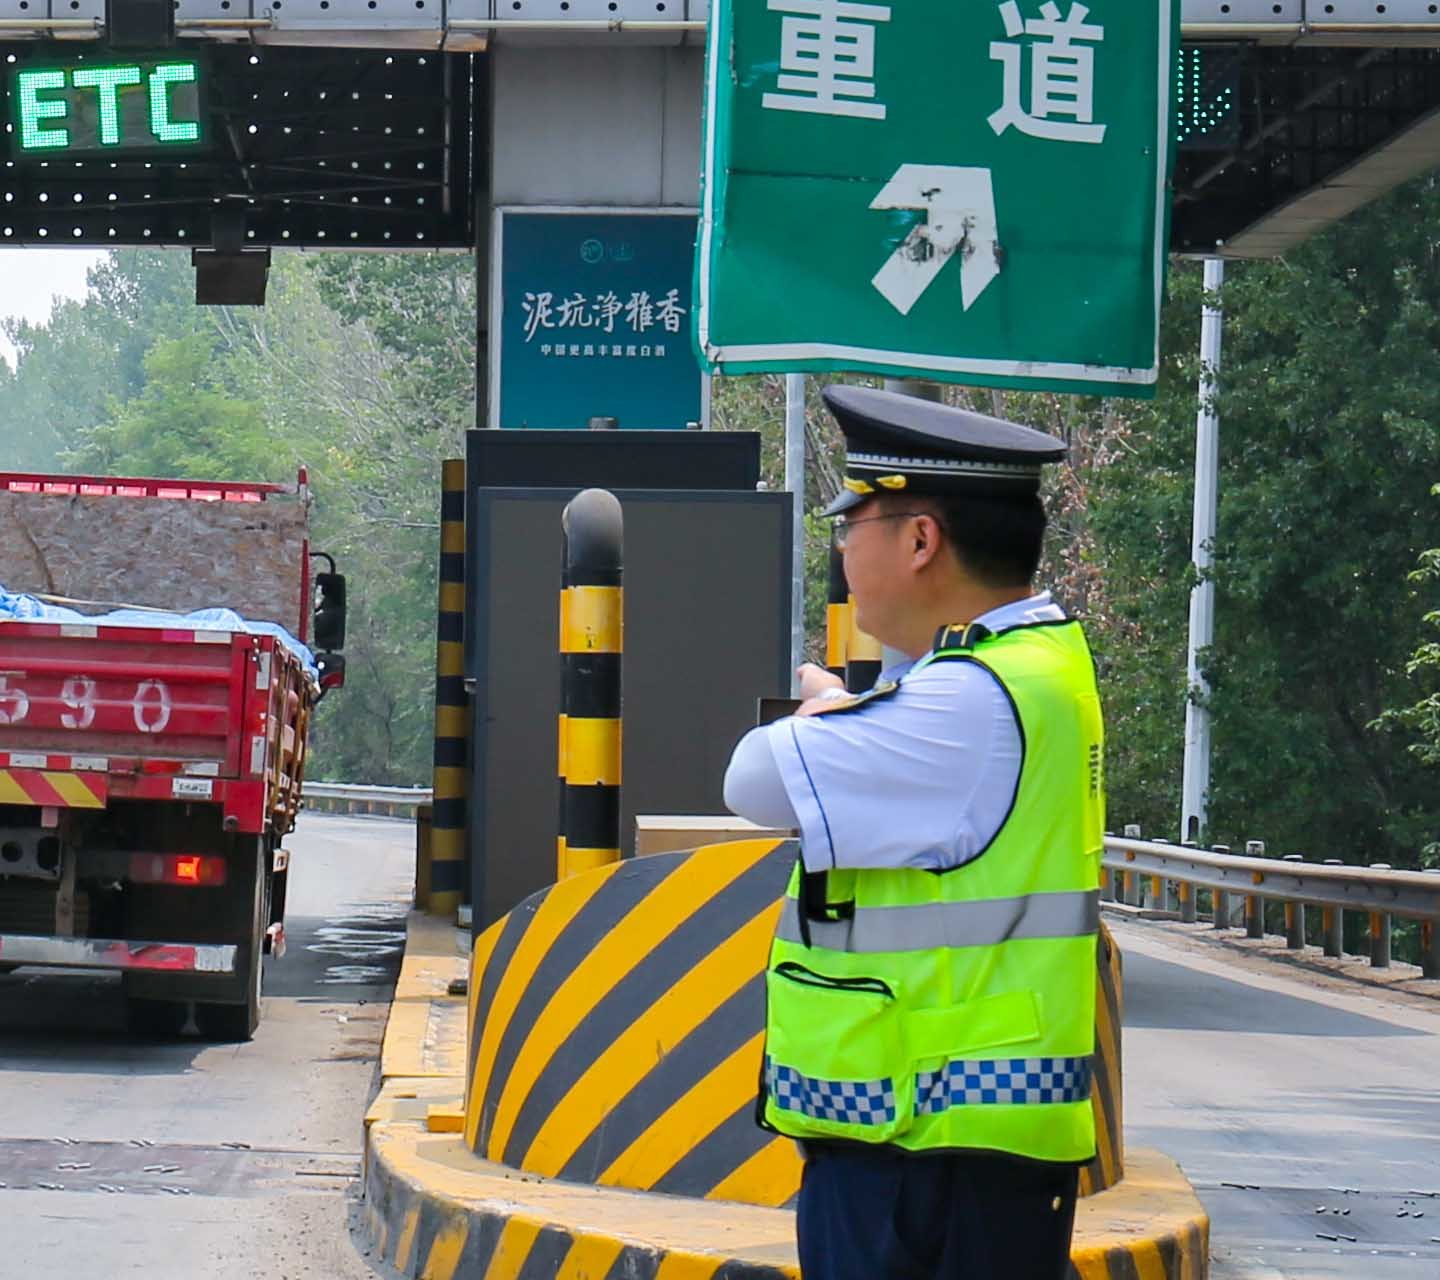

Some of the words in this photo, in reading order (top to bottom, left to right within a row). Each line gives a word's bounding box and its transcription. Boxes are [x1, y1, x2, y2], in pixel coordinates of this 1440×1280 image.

[18, 63, 198, 149] ETC
[521, 287, 687, 343] 泥坑净雅香
